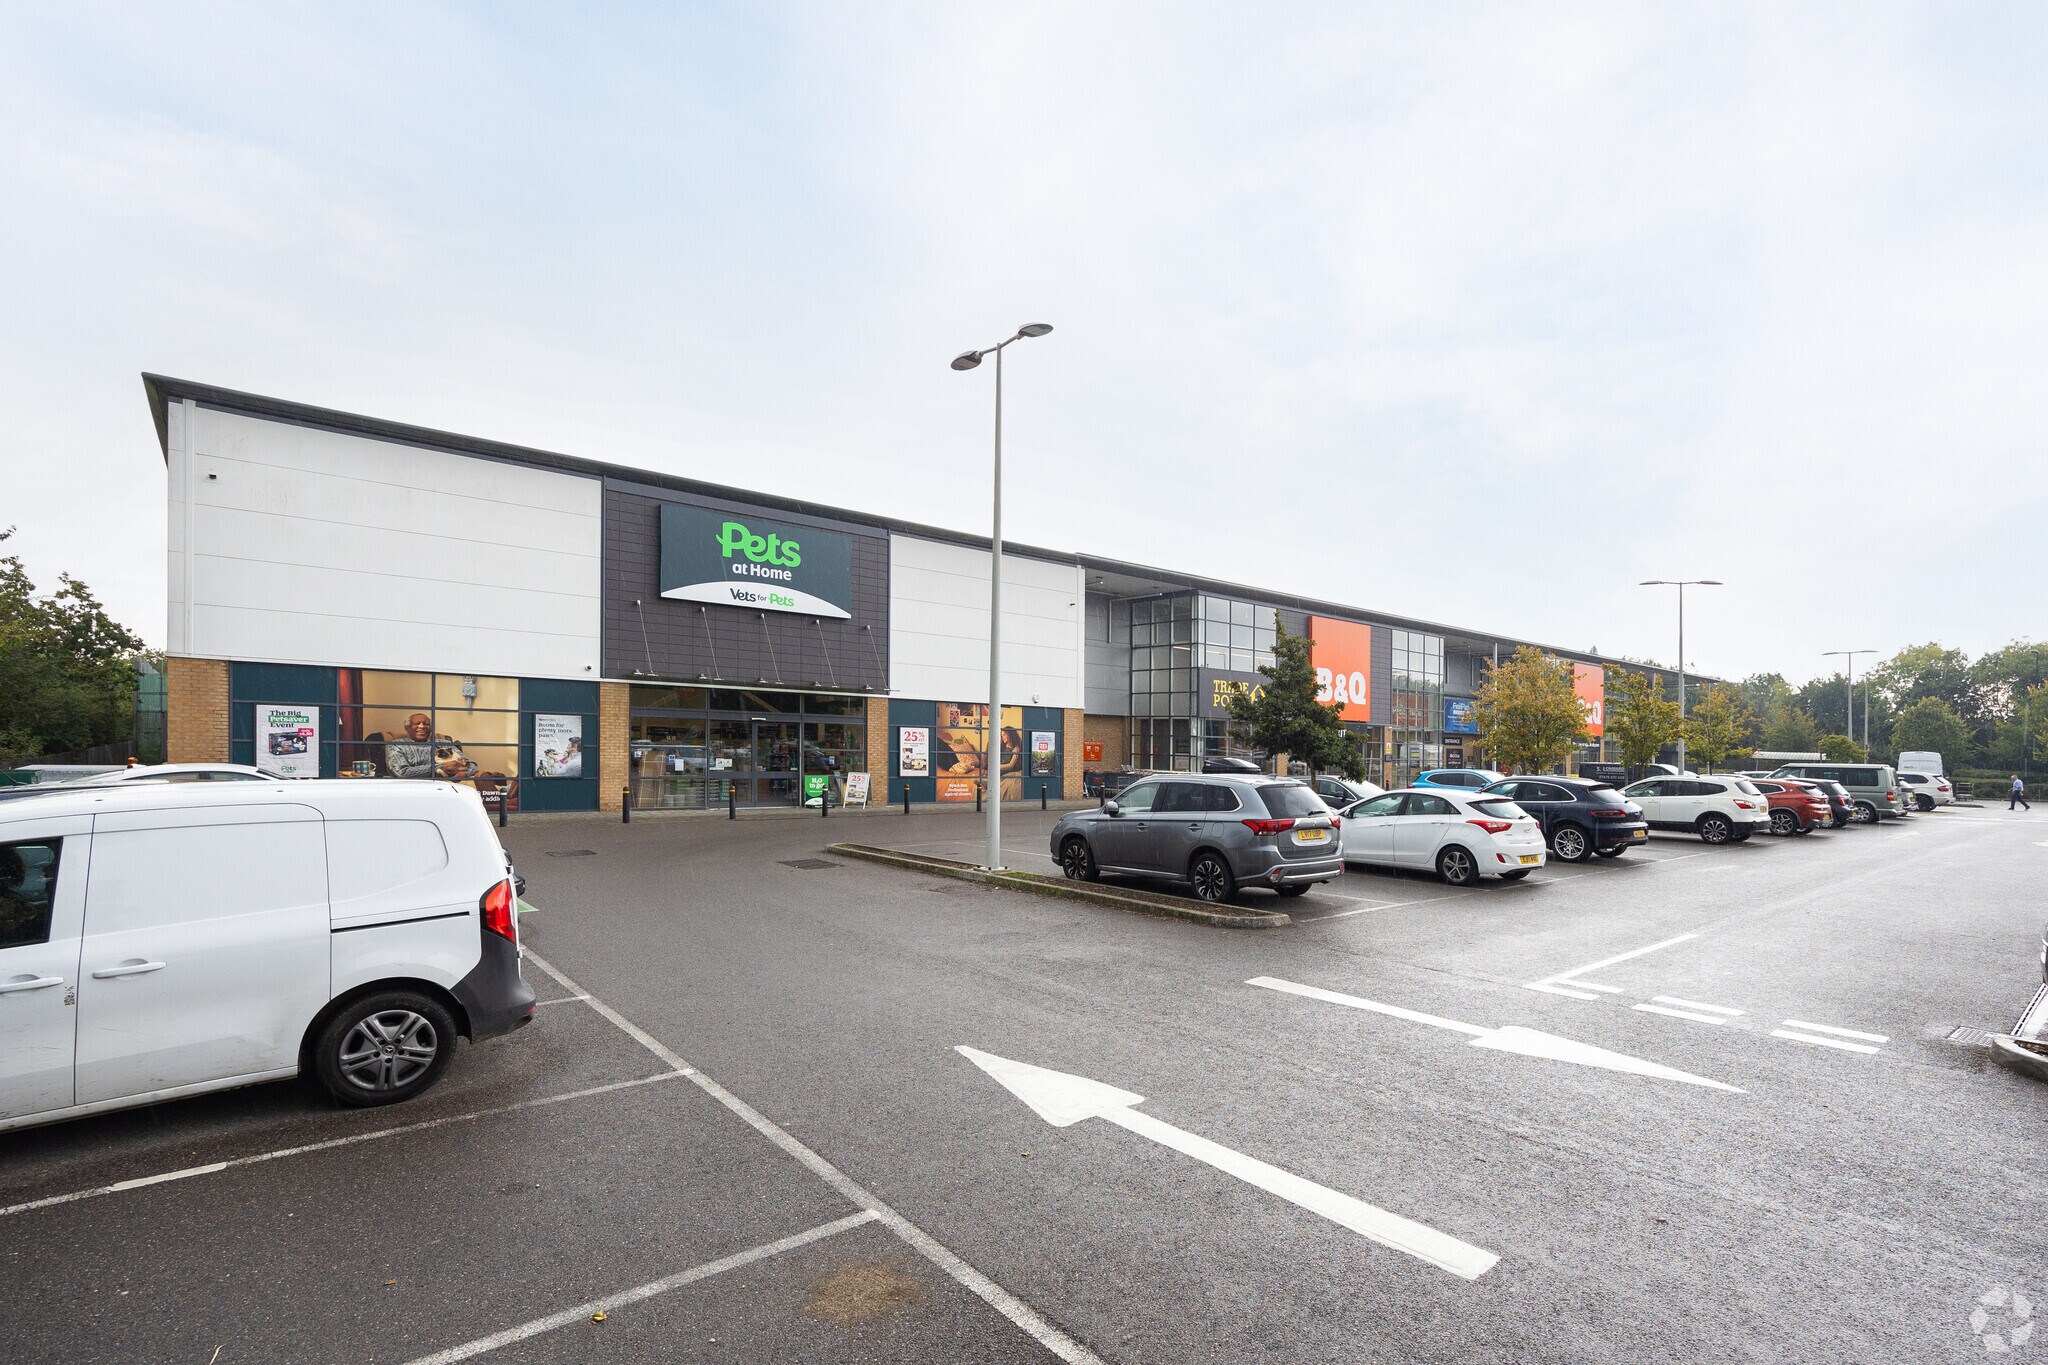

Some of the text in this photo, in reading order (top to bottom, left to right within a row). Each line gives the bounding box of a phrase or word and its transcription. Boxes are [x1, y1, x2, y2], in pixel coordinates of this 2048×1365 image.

[715, 521, 801, 567] Pets
[732, 563, 792, 580] at Home
[730, 588, 794, 607] Vets for Pets
[1316, 667, 1366, 704] B&Q
